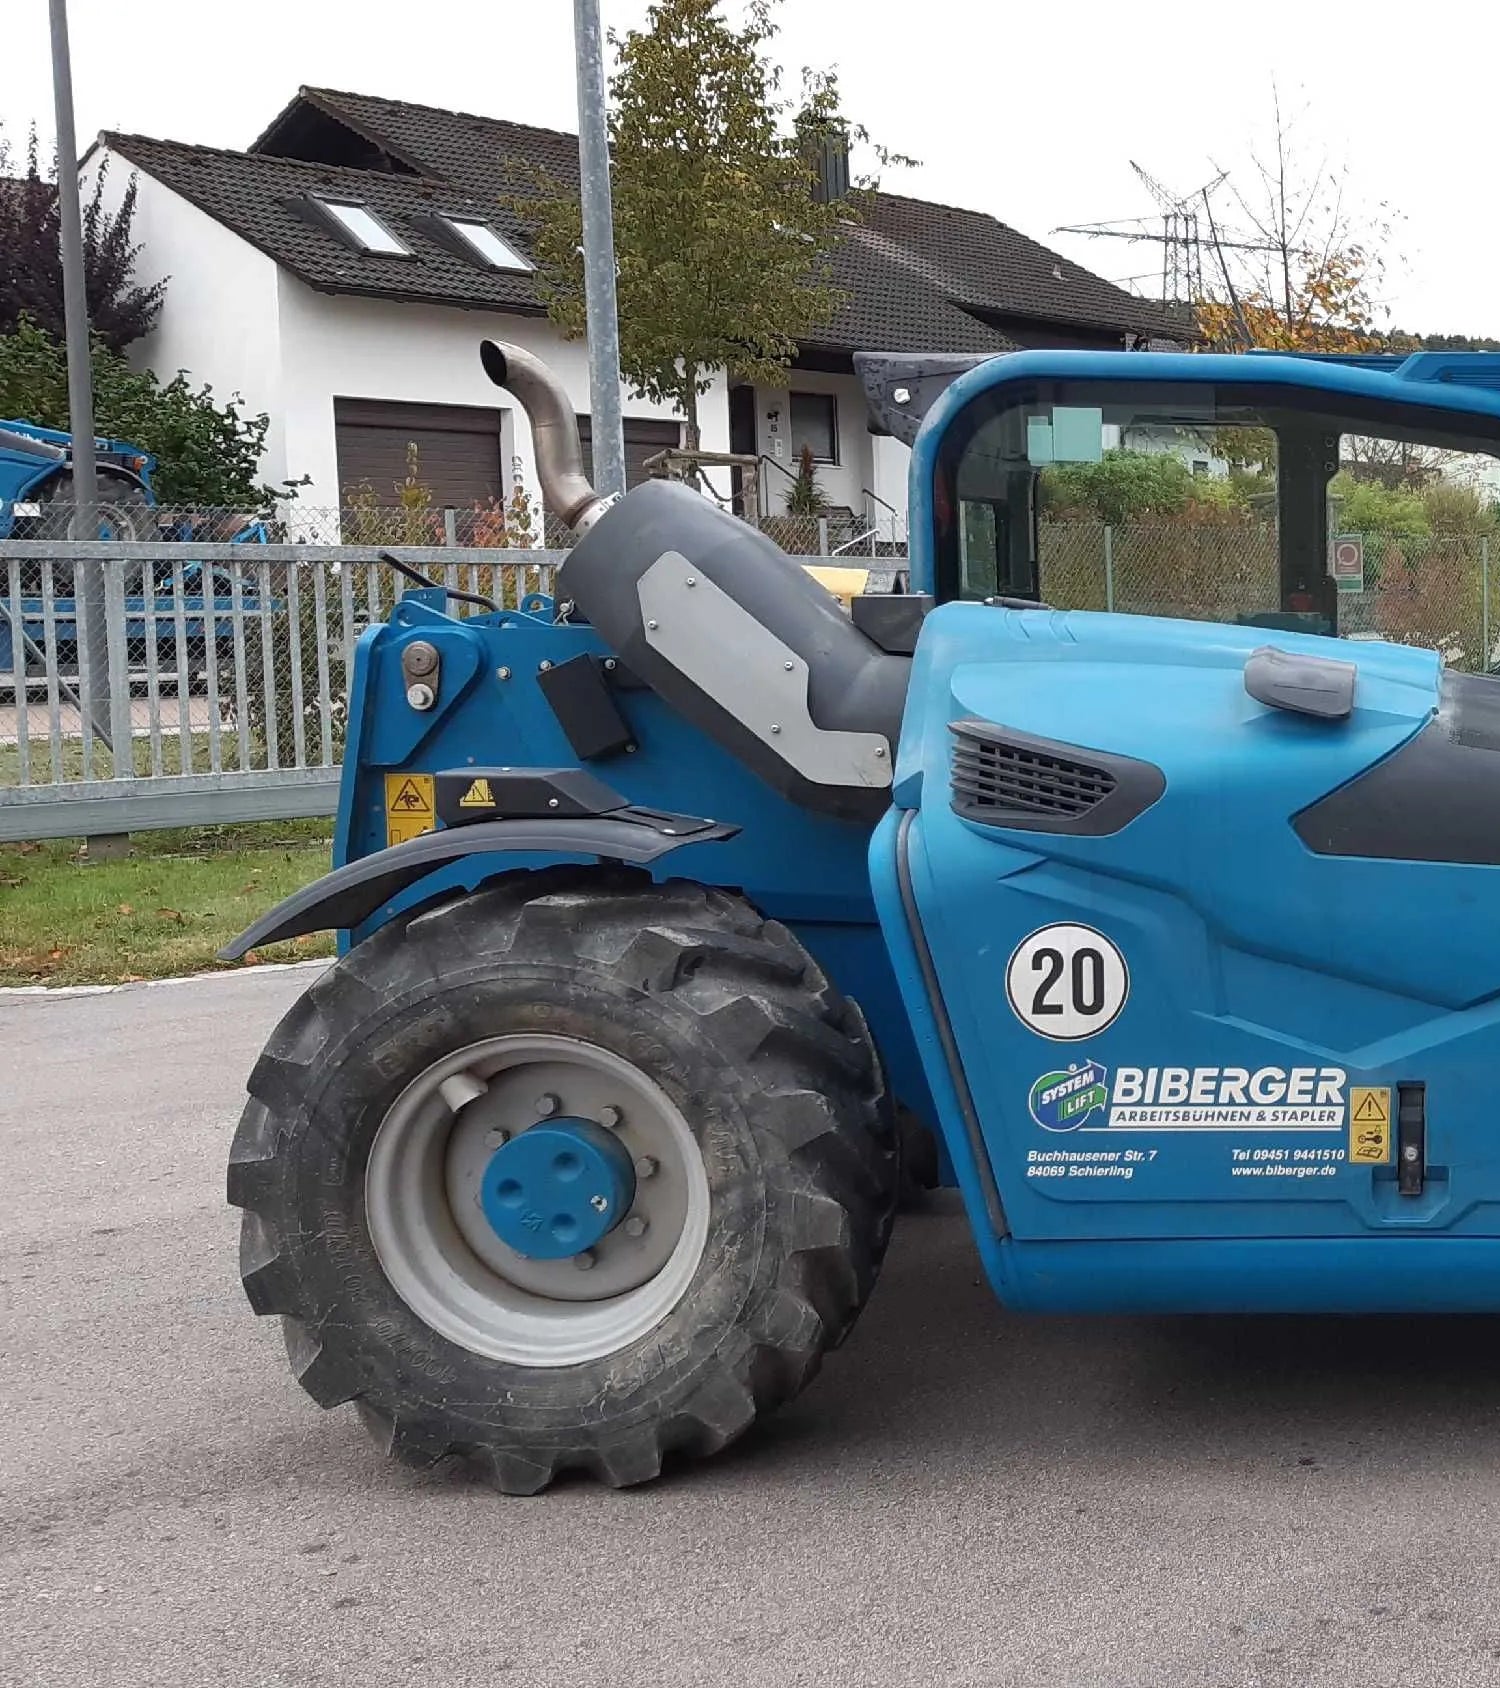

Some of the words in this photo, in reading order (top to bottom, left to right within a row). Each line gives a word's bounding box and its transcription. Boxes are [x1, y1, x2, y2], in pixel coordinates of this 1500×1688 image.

[1031, 947, 1105, 1016] 20
[1041, 1069, 1095, 1105] SYSTEM
[1111, 1066, 1347, 1105] BIBERGER
[1066, 1090, 1095, 1115] LIFT
[1115, 1108, 1252, 1123] ARBEITSBÜHNEN
[1256, 1109, 1268, 1122] &
[1269, 1109, 1337, 1123] STAPLER
[1026, 1149, 1121, 1163] Buchhausener
[1123, 1149, 1146, 1162] Str.
[1148, 1150, 1158, 1162] 7
[1231, 1148, 1250, 1161] Tel
[1253, 1149, 1289, 1161] 09451
[1292, 1149, 1345, 1161] 9441510
[1026, 1165, 1066, 1177] 84069
[1068, 1165, 1134, 1179] Schierling
[1231, 1165, 1337, 1178] www.biberger.de
